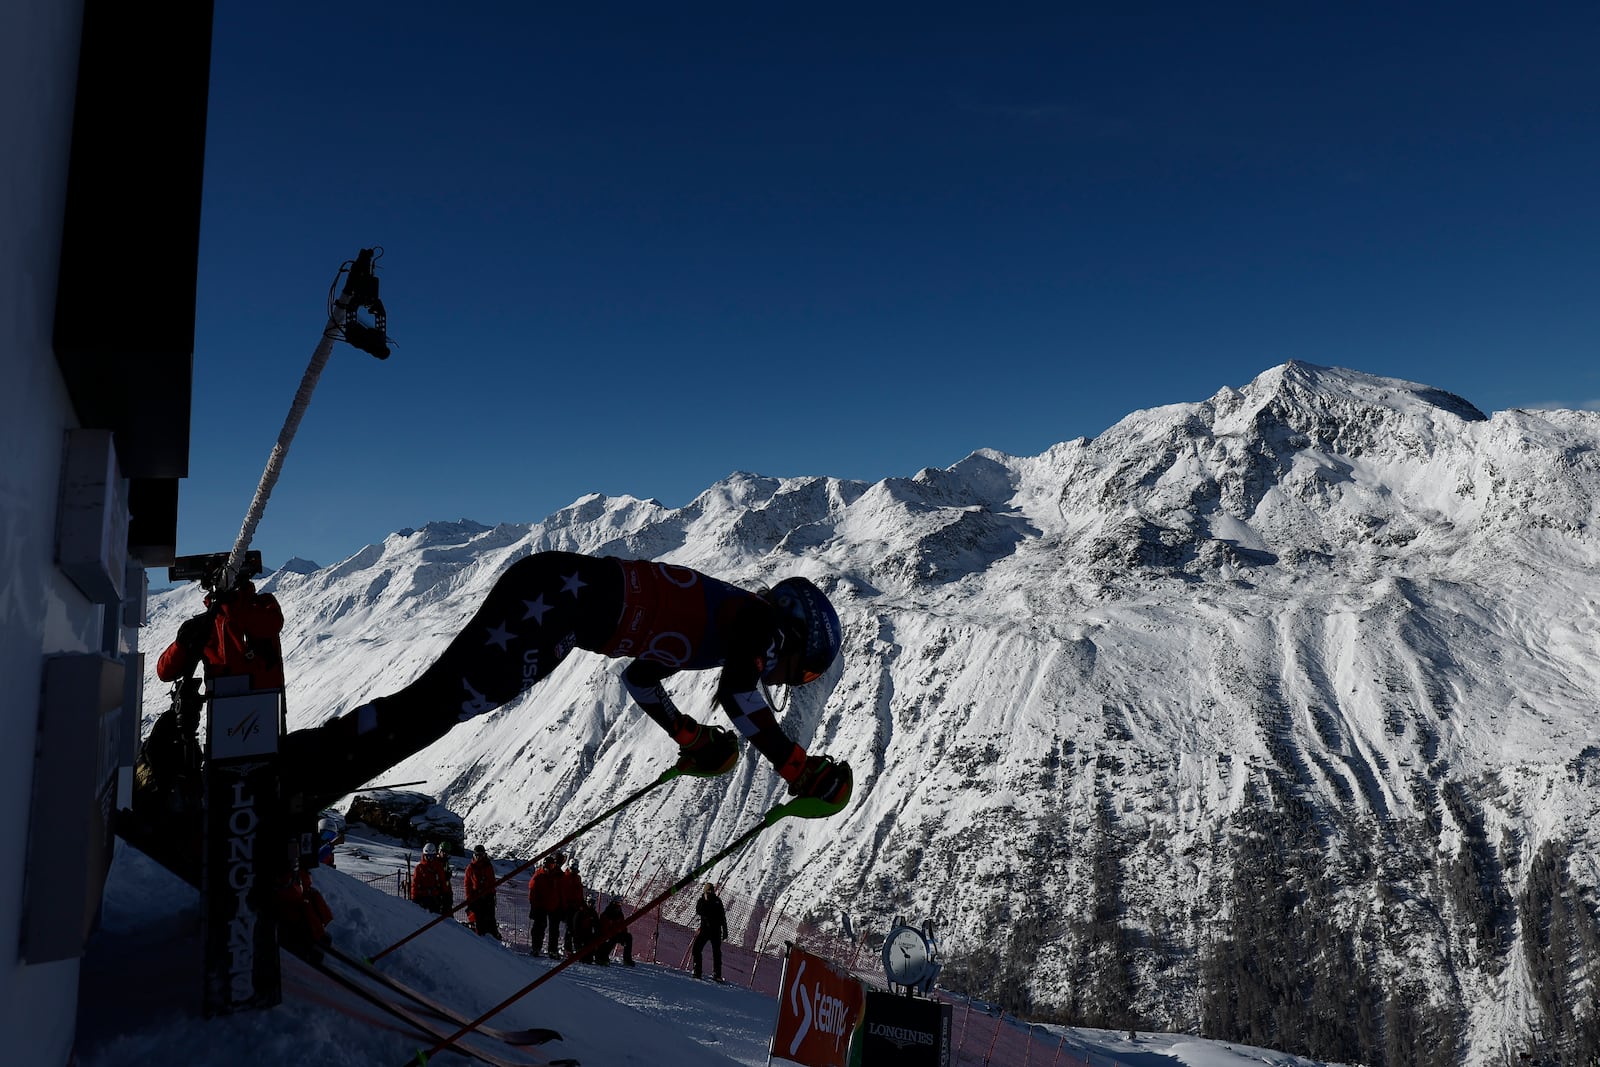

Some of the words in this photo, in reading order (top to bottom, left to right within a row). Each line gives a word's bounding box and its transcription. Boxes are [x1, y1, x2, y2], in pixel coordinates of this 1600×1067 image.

[820, 610, 836, 647] ATOMIC
[520, 648, 540, 692] USA
[228, 784, 258, 1002] LONGINES
[868, 1022, 935, 1047] LONGINES
